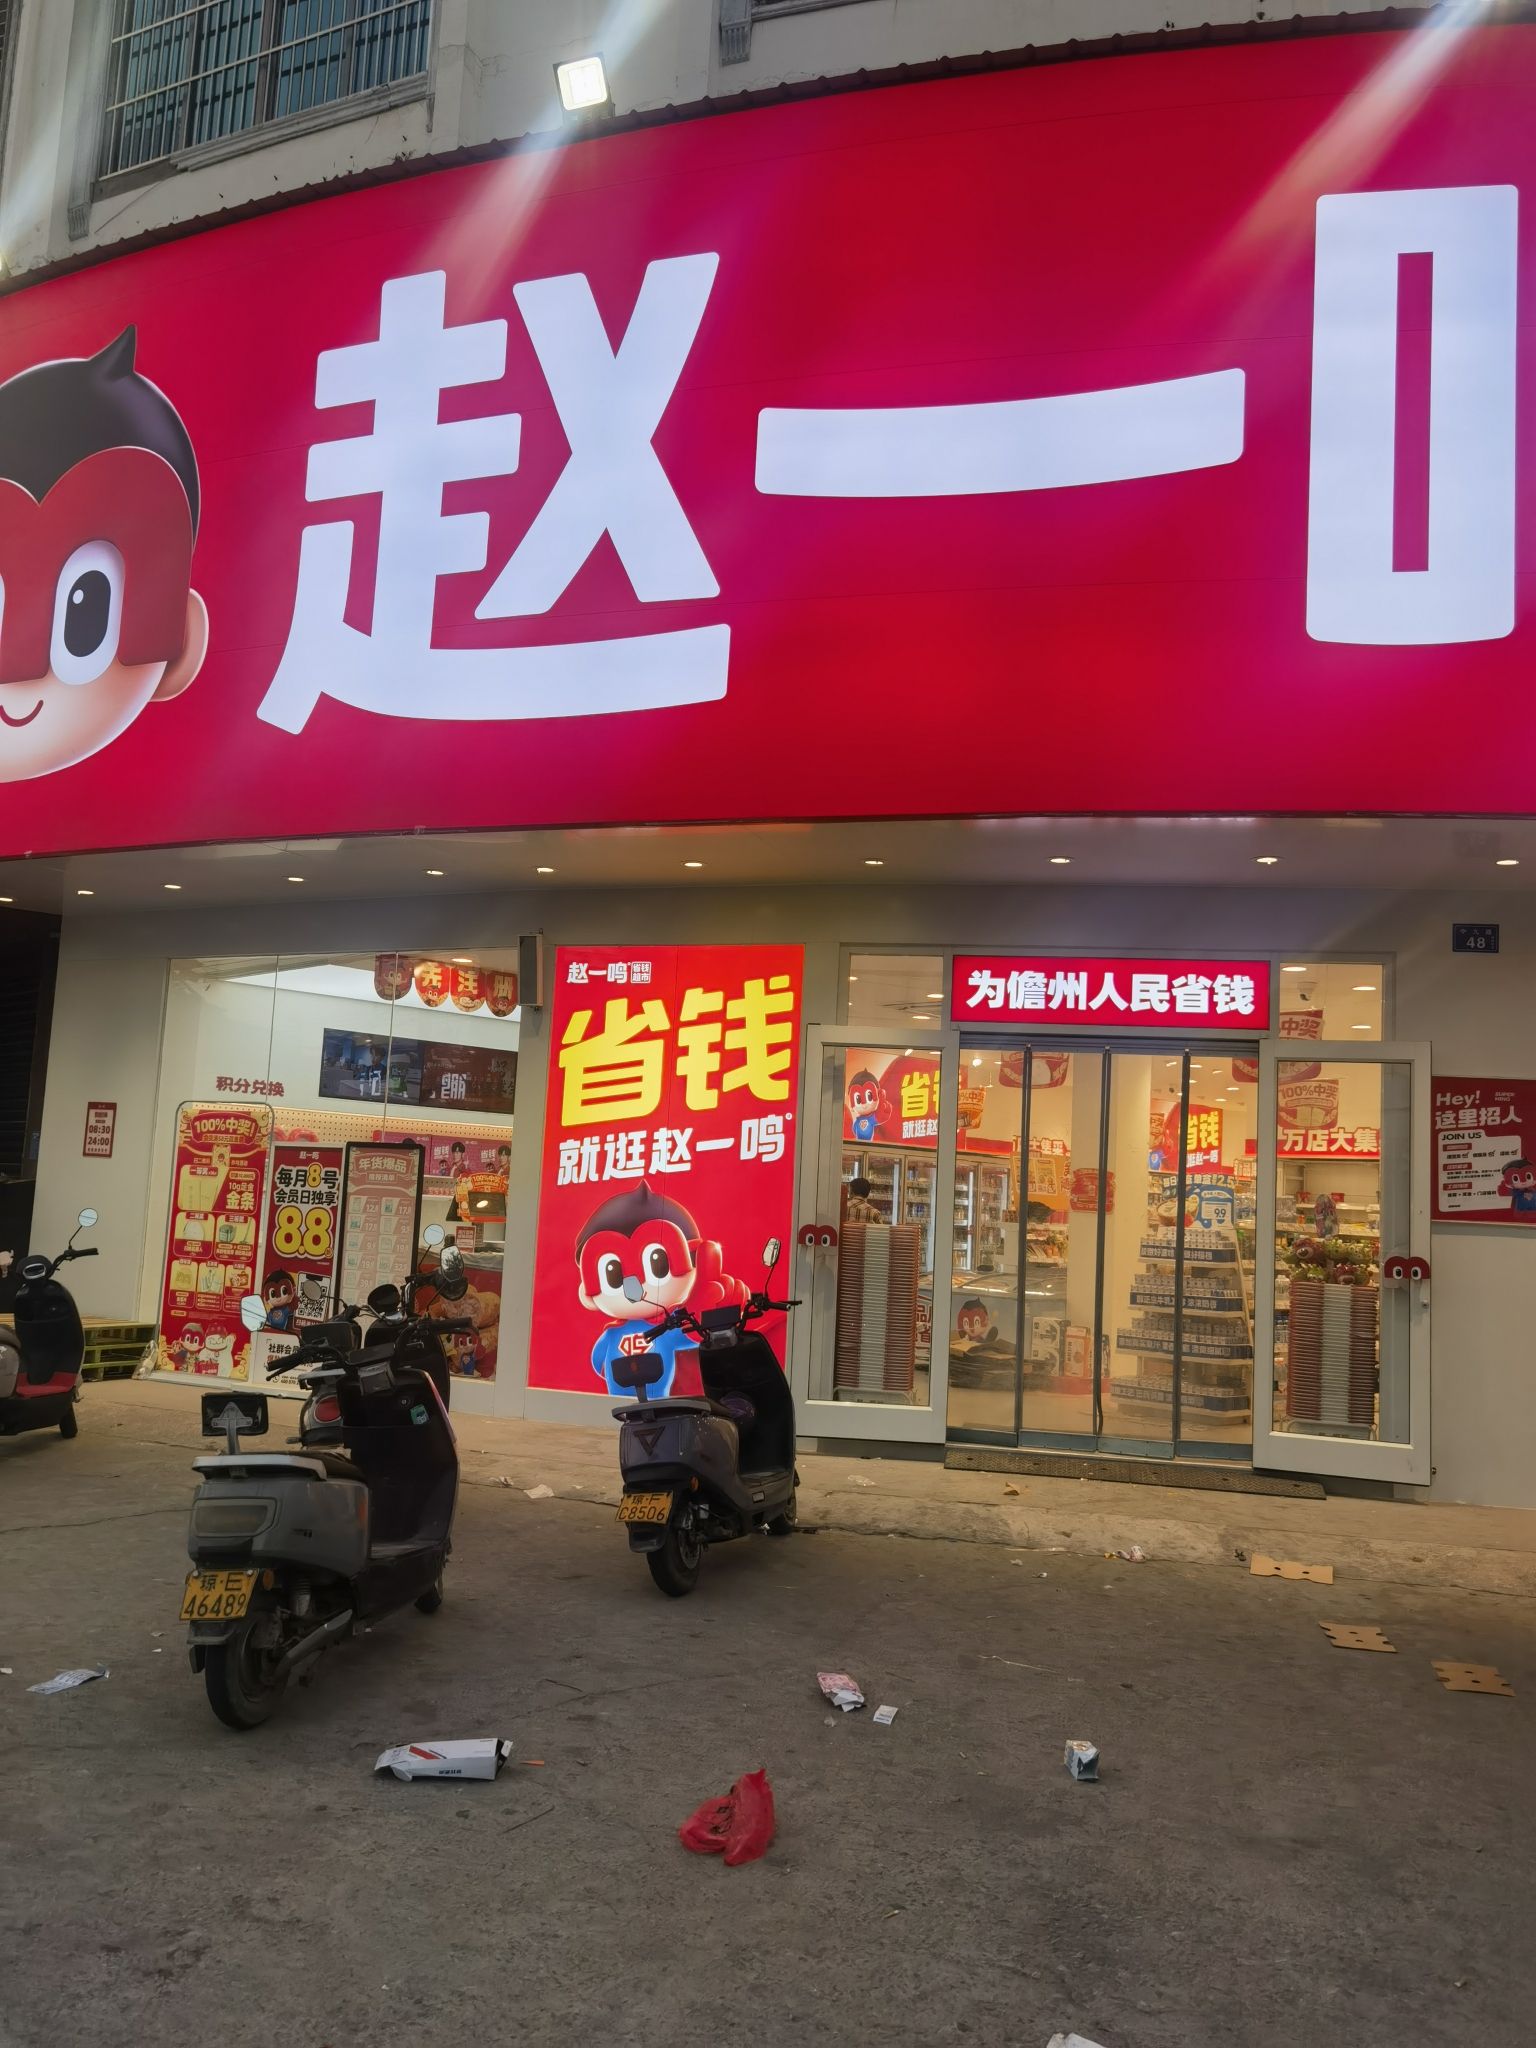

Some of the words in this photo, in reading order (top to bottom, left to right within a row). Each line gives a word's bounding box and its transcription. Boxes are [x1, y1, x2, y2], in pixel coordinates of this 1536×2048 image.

[1466, 936, 1486, 949] 48
[566, 961, 628, 984] 赵一鸣
[966, 969, 1256, 1015] 为儋州人民省钱
[558, 975, 794, 1127] 省钱
[216, 1076, 285, 1097] 积分兑换
[1436, 1090, 1480, 1108] Hey!
[1435, 1105, 1522, 1130] 这里招人
[88, 1124, 110, 1134] 08:30
[1283, 1127, 1380, 1152] 万店大集
[1441, 1132, 1465, 1141] JOIN
[1467, 1131, 1482, 1139] US
[87, 1136, 110, 1146] 24:00
[557, 1114, 785, 1185] 就逛赵一鸣
[276, 1163, 339, 1189] 每月8号
[225, 1191, 254, 1210] 金条
[275, 1188, 337, 1206] 会员日独享
[275, 1205, 332, 1256] 8.8
[618, 1505, 665, 1521] C8506
[184, 1593, 248, 1618] 46489
